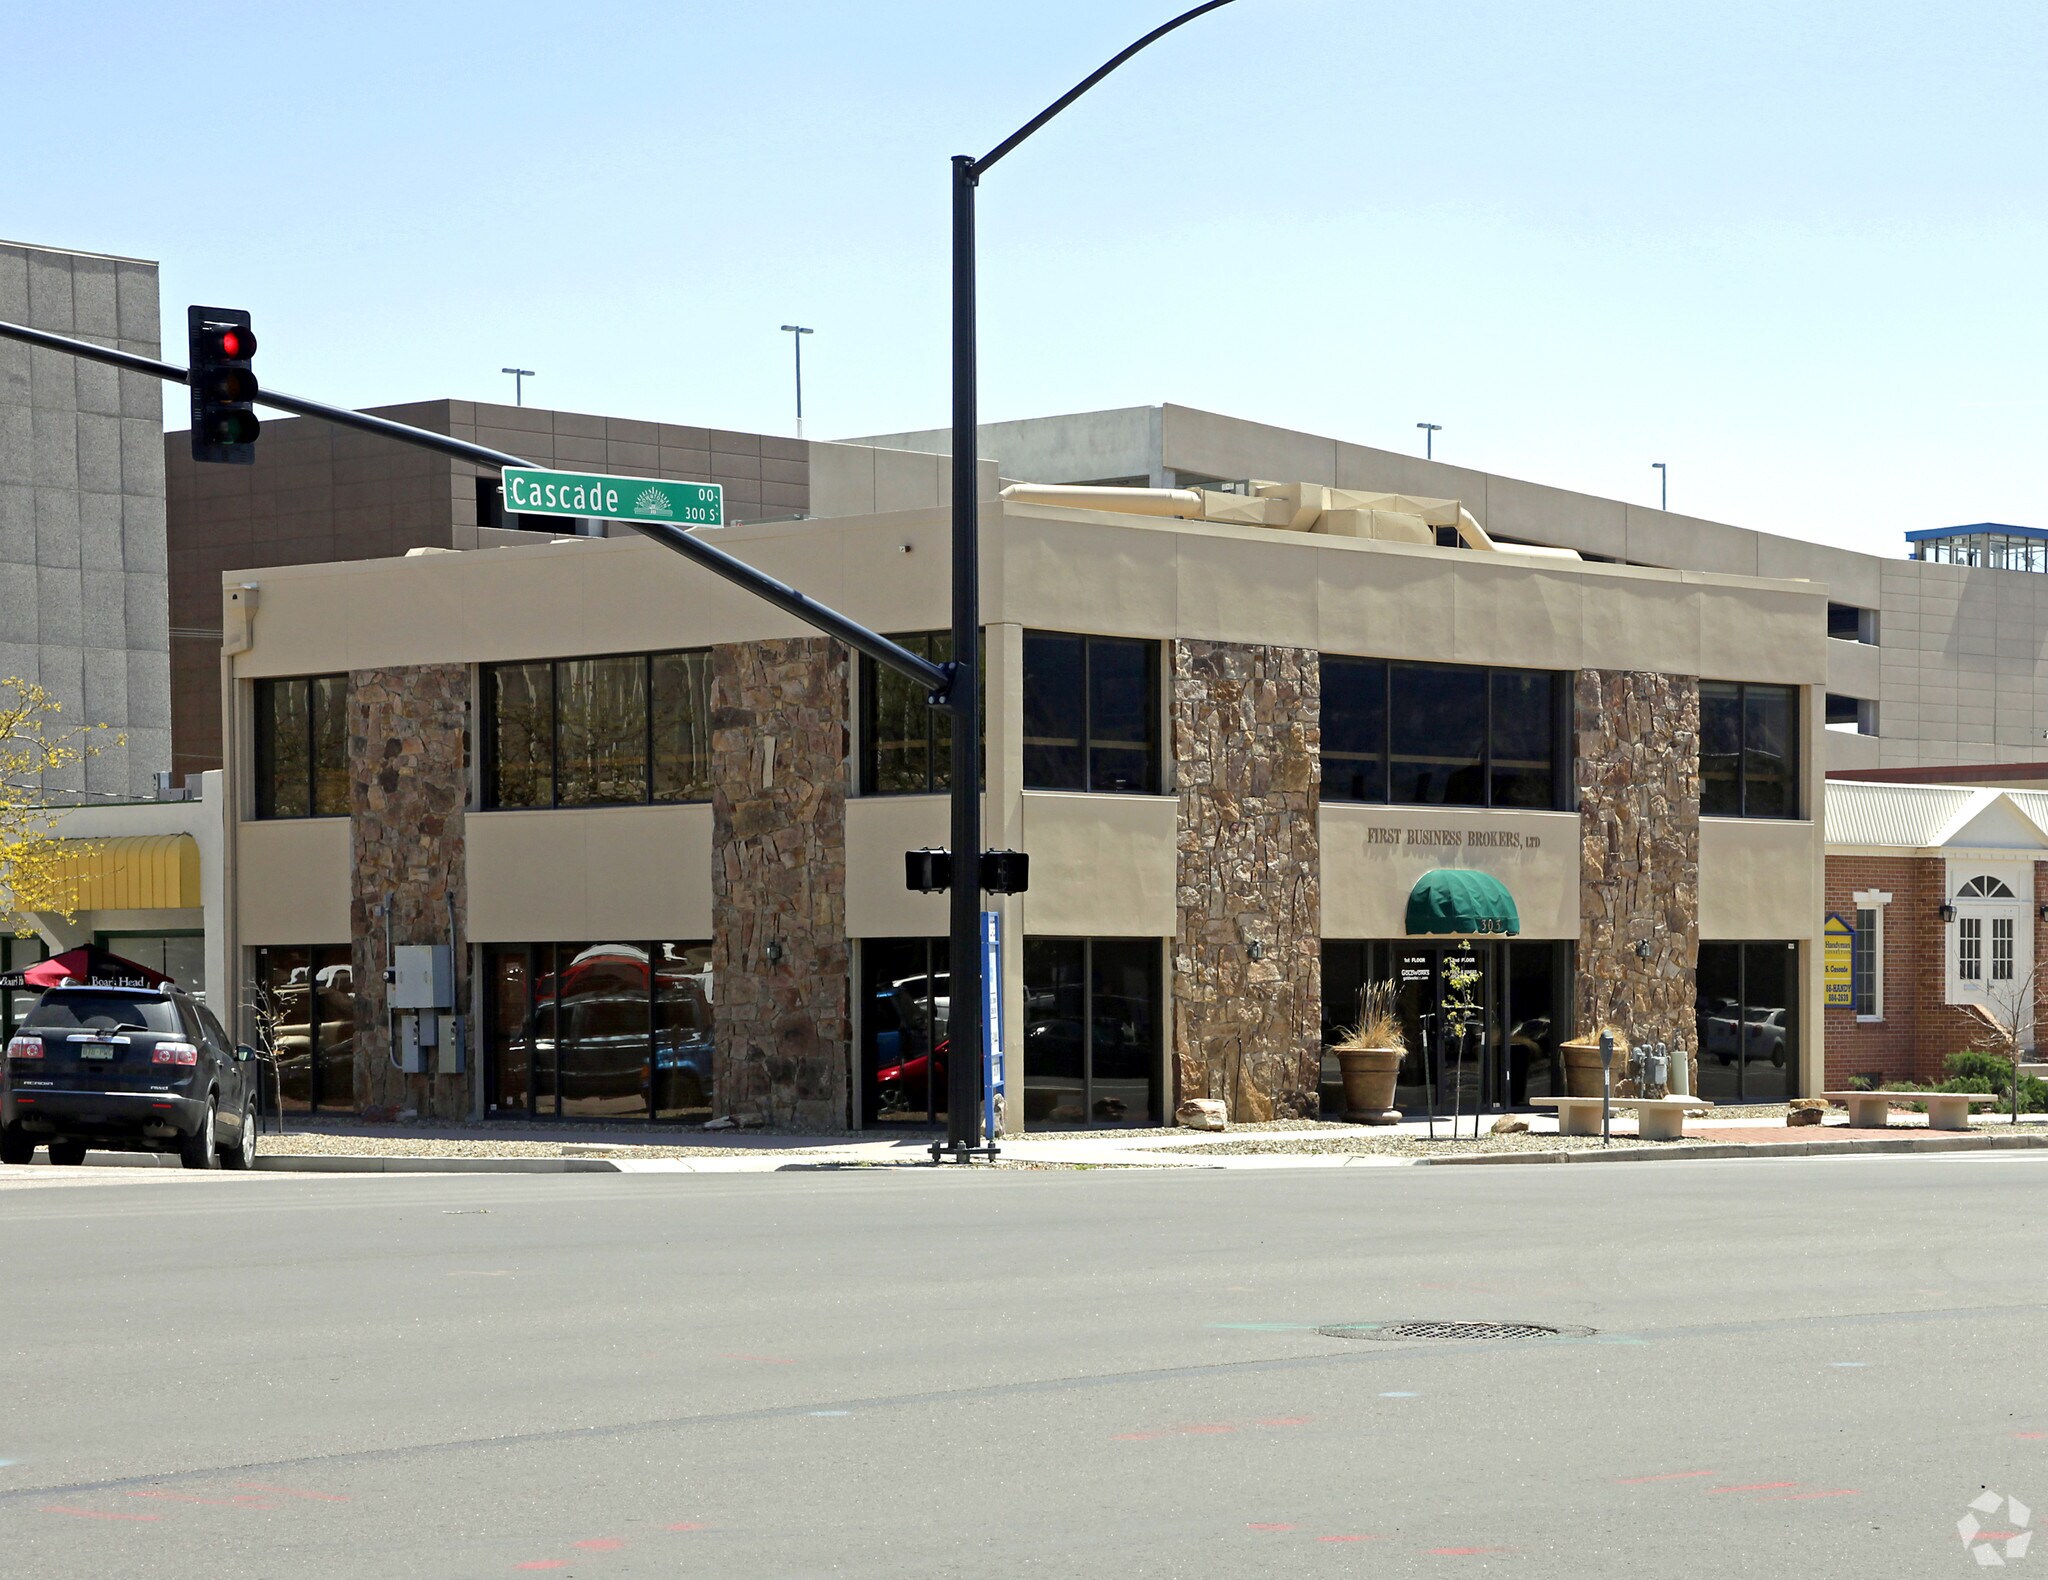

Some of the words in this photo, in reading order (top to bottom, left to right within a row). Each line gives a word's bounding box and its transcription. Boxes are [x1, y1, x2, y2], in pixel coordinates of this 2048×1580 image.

[511, 476, 619, 513] Cascade
[698, 488, 714, 502] 00
[685, 507, 706, 521] 300
[709, 509, 715, 521] S
[1367, 827, 1402, 844] FIRST
[1407, 829, 1462, 846] BUSINESS
[1468, 831, 1523, 850] BROKERS,
[1525, 836, 1541, 848] LTD
[1481, 919, 1502, 931] 303
[119, 976, 144, 987] Head
